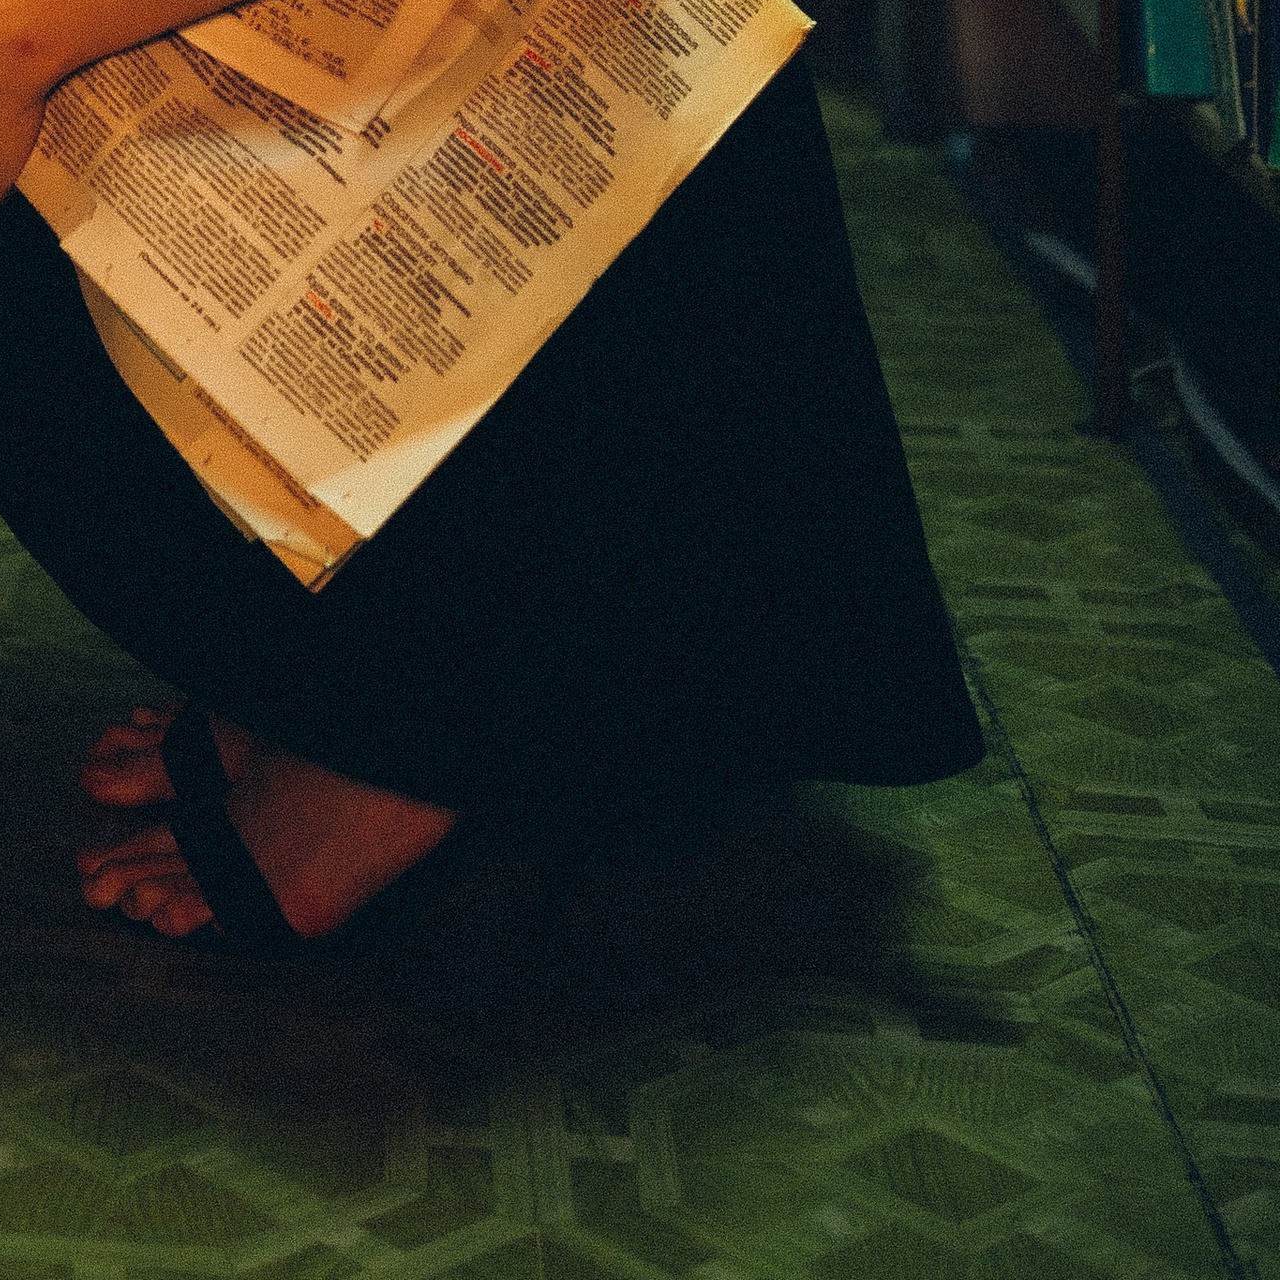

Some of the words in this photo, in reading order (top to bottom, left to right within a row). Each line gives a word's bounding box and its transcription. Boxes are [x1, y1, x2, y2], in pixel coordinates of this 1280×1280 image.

[531, 18, 568, 58] Только
[565, 50, 588, 75] тем,
[647, 0, 657, 10] и
[655, 6, 699, 52] здоровья
[547, 50, 563, 68] по
[561, 62, 610, 114] средствам
[452, 108, 481, 138] Ряды
[479, 131, 518, 172] казаков
[515, 166, 577, 231] пополнились
[370, 200, 437, 270] контролируют
[379, 190, 431, 245] Спасатели
[426, 236, 476, 288] ситуацию
[304, 271, 331, 300] Куда
[326, 294, 358, 328] едем,
[355, 322, 376, 345] что
[373, 338, 412, 379] везем?
